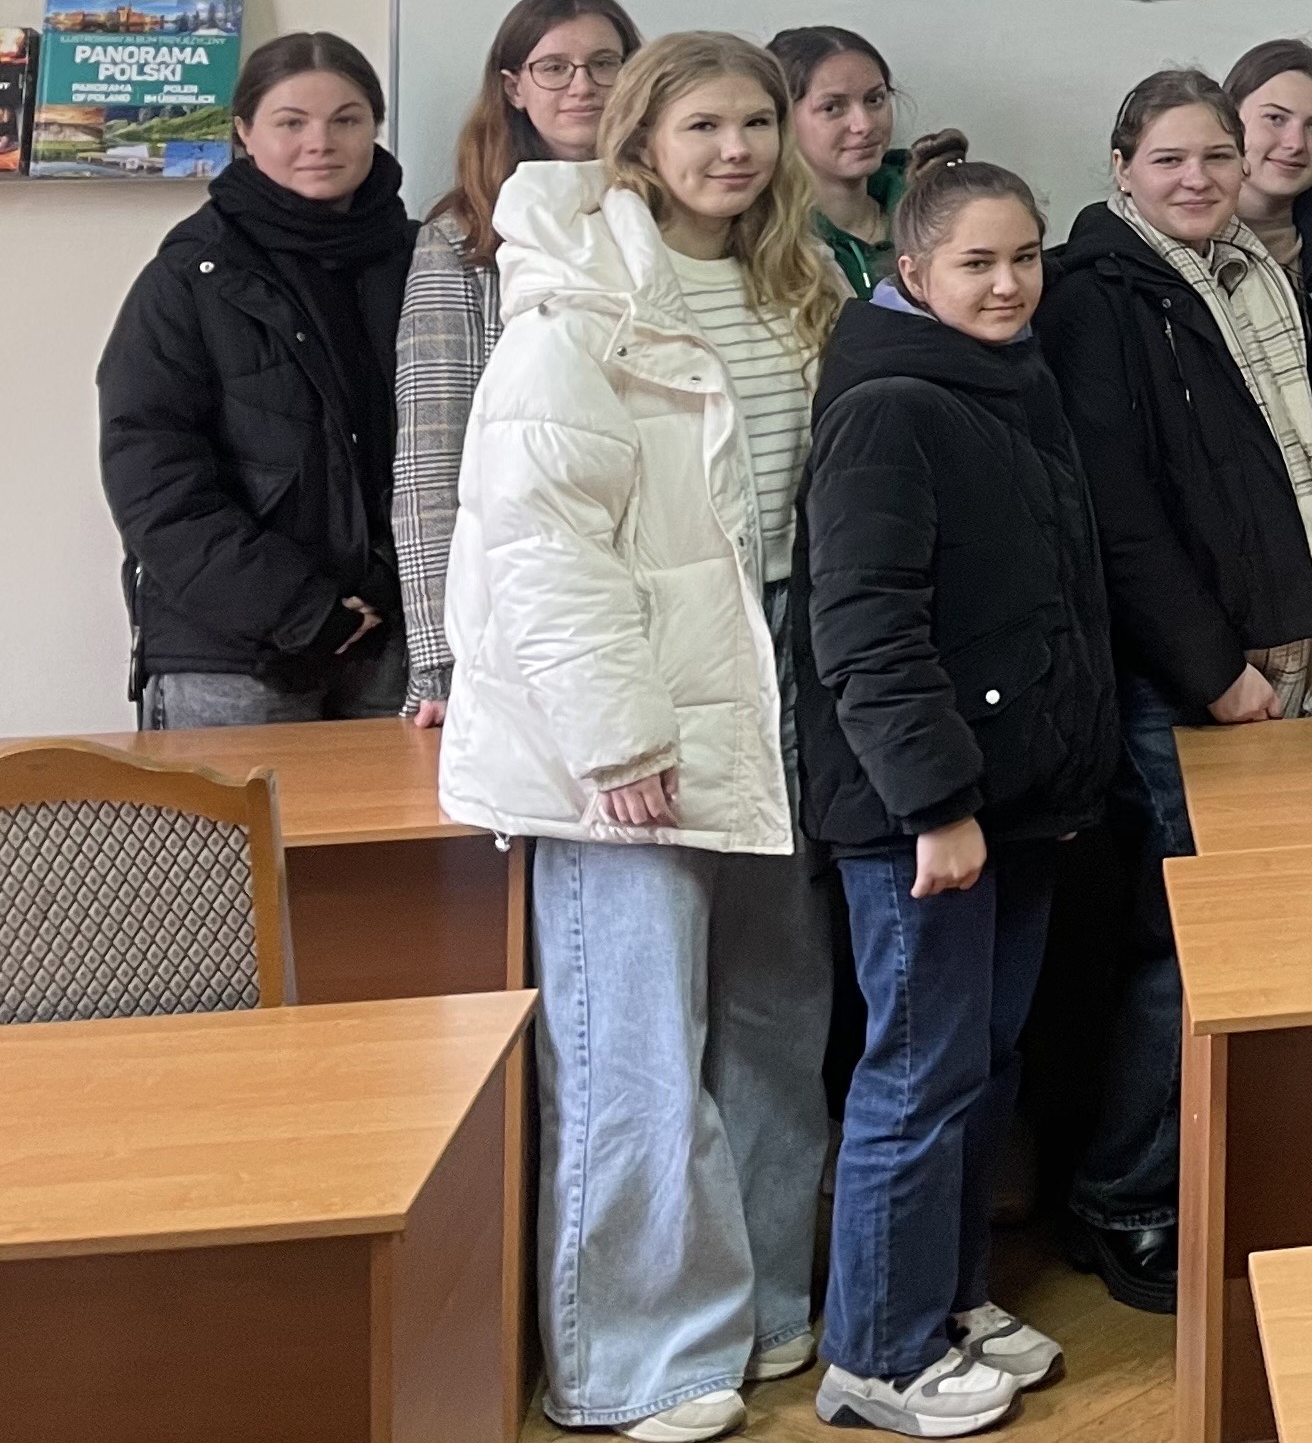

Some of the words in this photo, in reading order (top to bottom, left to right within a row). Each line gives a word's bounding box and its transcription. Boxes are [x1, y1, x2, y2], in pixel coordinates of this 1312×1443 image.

[74, 45, 210, 65] PANORAMA
[98, 63, 182, 82] POLSKI
[71, 83, 132, 93] PANORAMA
